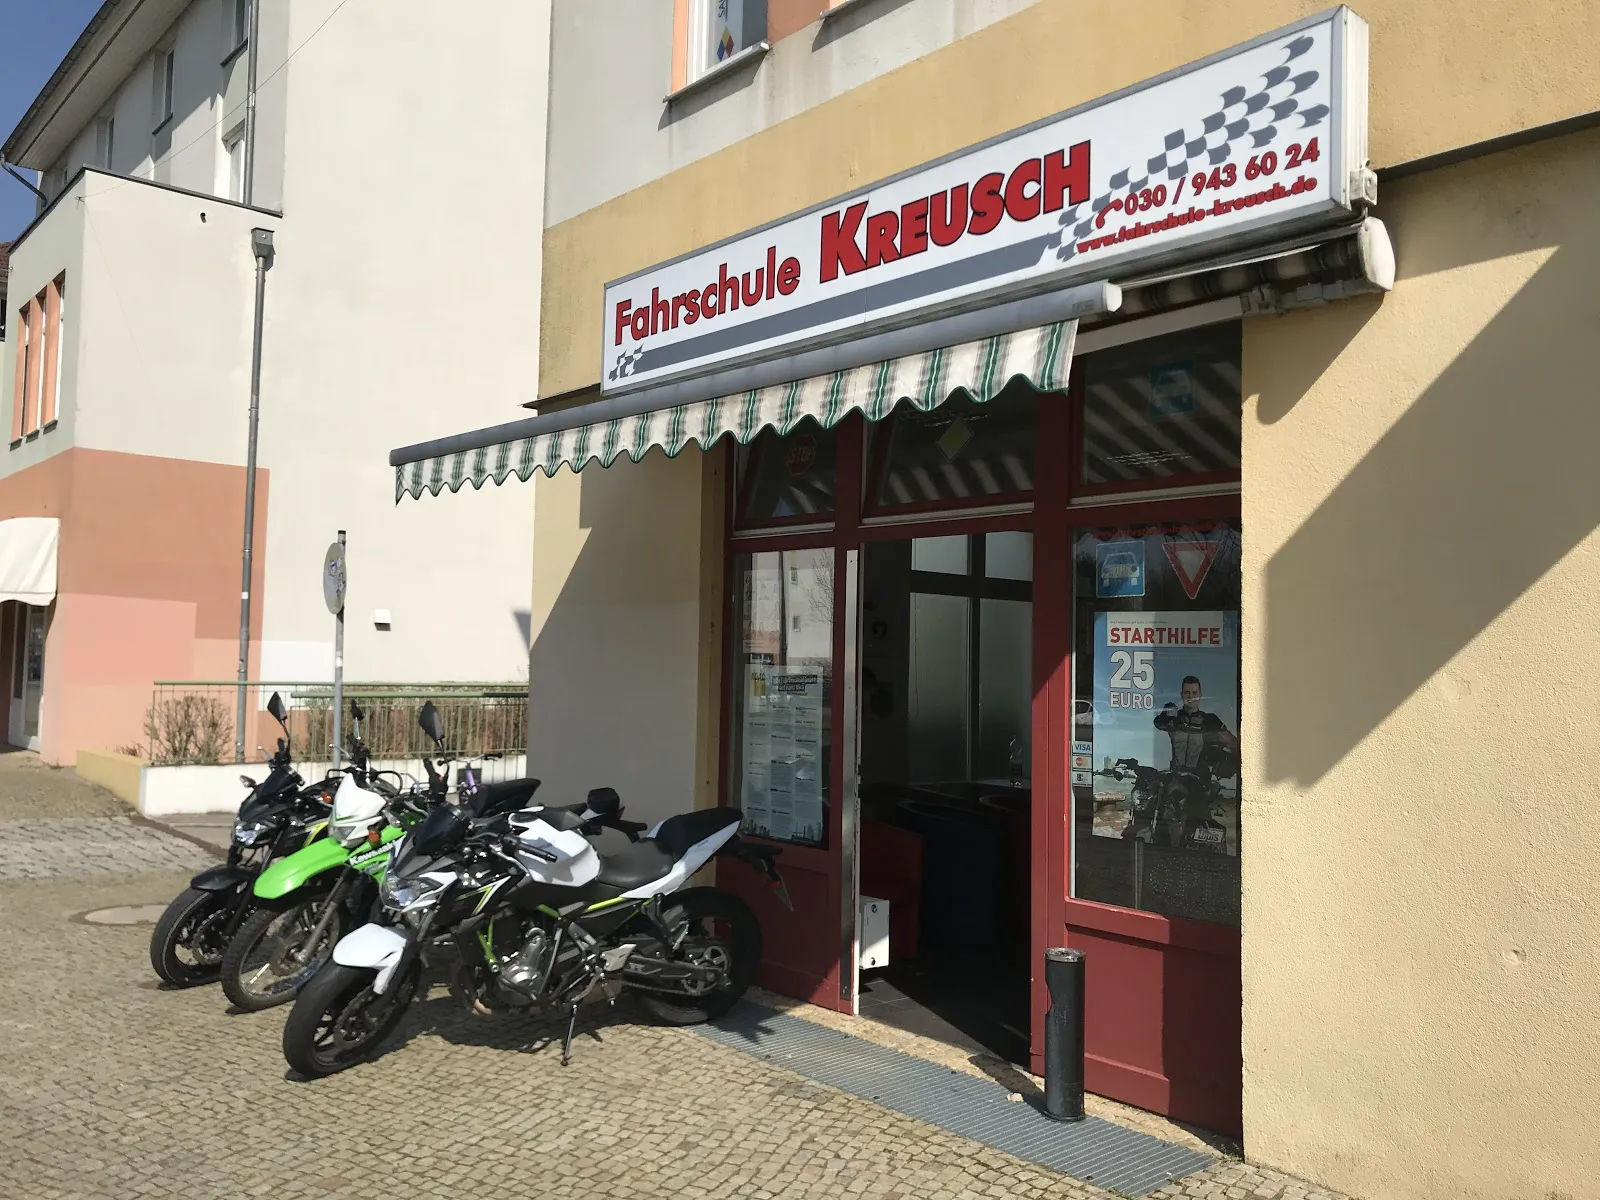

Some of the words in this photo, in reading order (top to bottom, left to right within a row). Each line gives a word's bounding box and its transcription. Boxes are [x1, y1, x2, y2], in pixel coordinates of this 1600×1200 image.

[1124, 183, 1167, 215] 030
[1172, 176, 1186, 205] /
[1191, 163, 1237, 196] 943
[1244, 150, 1278, 180] 60
[1284, 136, 1321, 171] 24
[1077, 174, 1318, 254] www.fahrschule-kreusch.de
[614, 246, 801, 346] Fahrschule
[819, 139, 1092, 284] KREUSCH
[1110, 627, 1221, 645] STARTHILFE
[1110, 649, 1156, 691] 25
[1109, 691, 1155, 710] EURO
[1074, 743, 1091, 752] VISA
